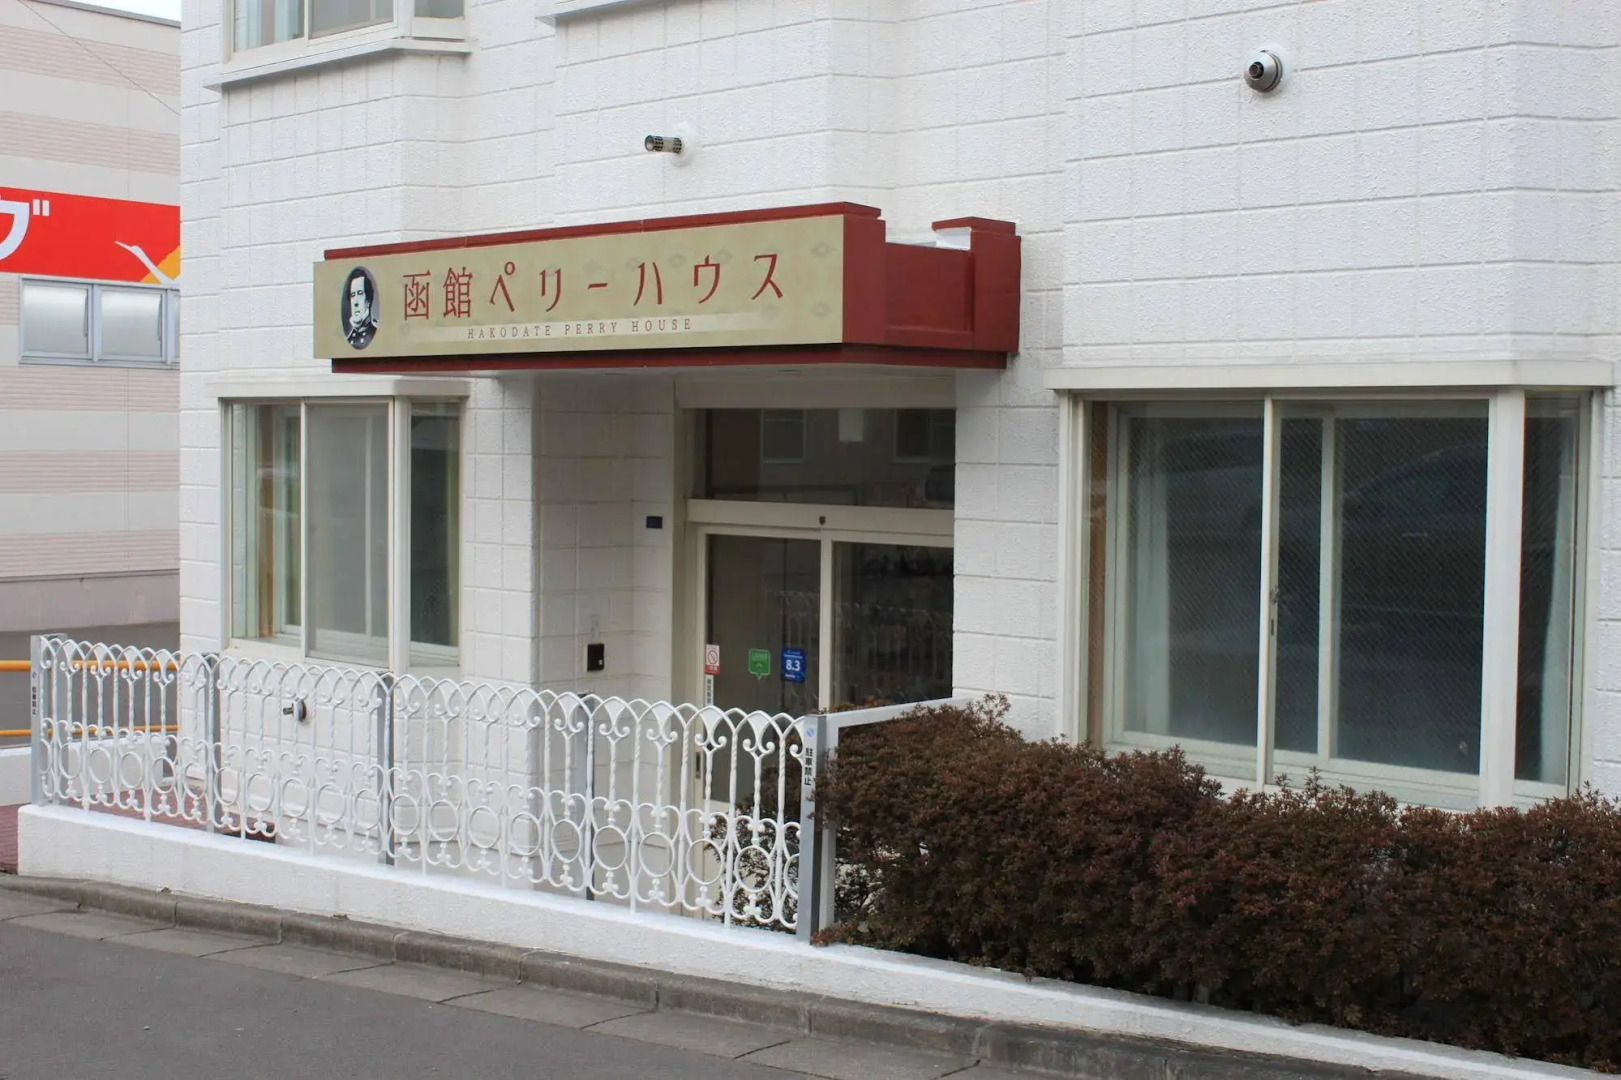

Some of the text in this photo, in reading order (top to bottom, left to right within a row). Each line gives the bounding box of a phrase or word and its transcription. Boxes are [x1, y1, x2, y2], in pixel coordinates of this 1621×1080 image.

[403, 254, 784, 320] 函館ペリーハウス
[467, 318, 691, 339] HAKODATE PERRY HOUSE
[786, 659, 801, 671] 8.3
